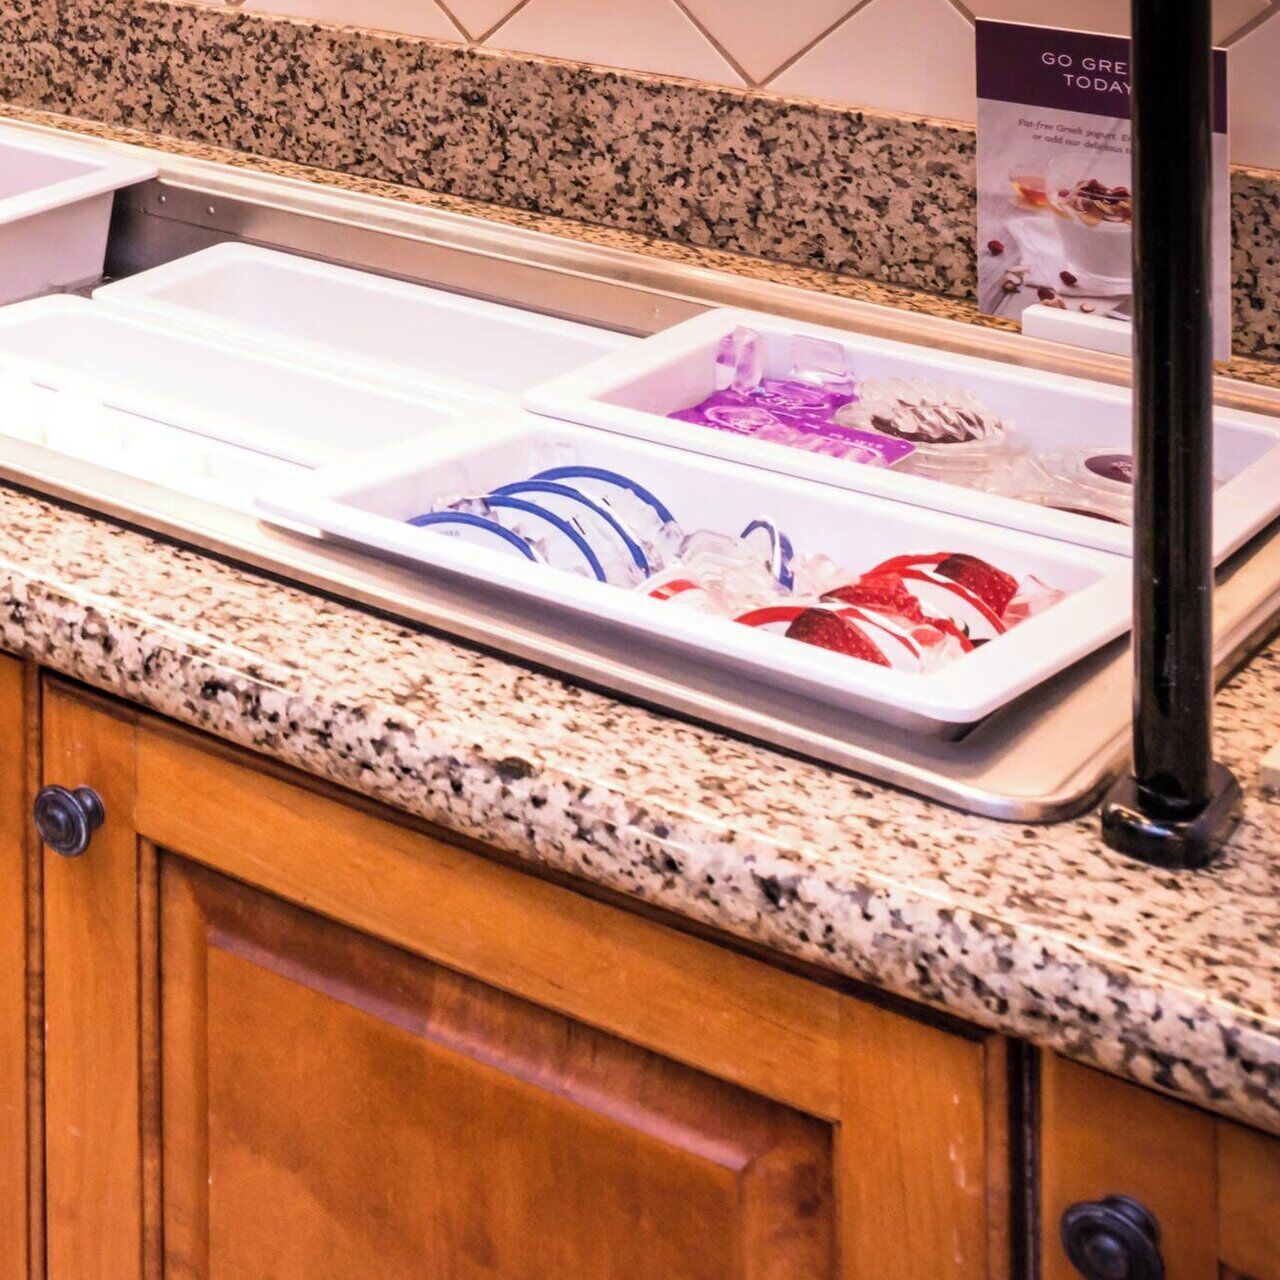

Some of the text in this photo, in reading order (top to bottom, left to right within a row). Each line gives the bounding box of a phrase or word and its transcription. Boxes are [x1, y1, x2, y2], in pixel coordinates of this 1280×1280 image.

[1041, 52, 1128, 76] GO GRE
[1062, 73, 1133, 96] TODAY
[1018, 118, 1054, 131] Fat-free
[1056, 123, 1083, 135] Greek
[1044, 134, 1063, 145] add
